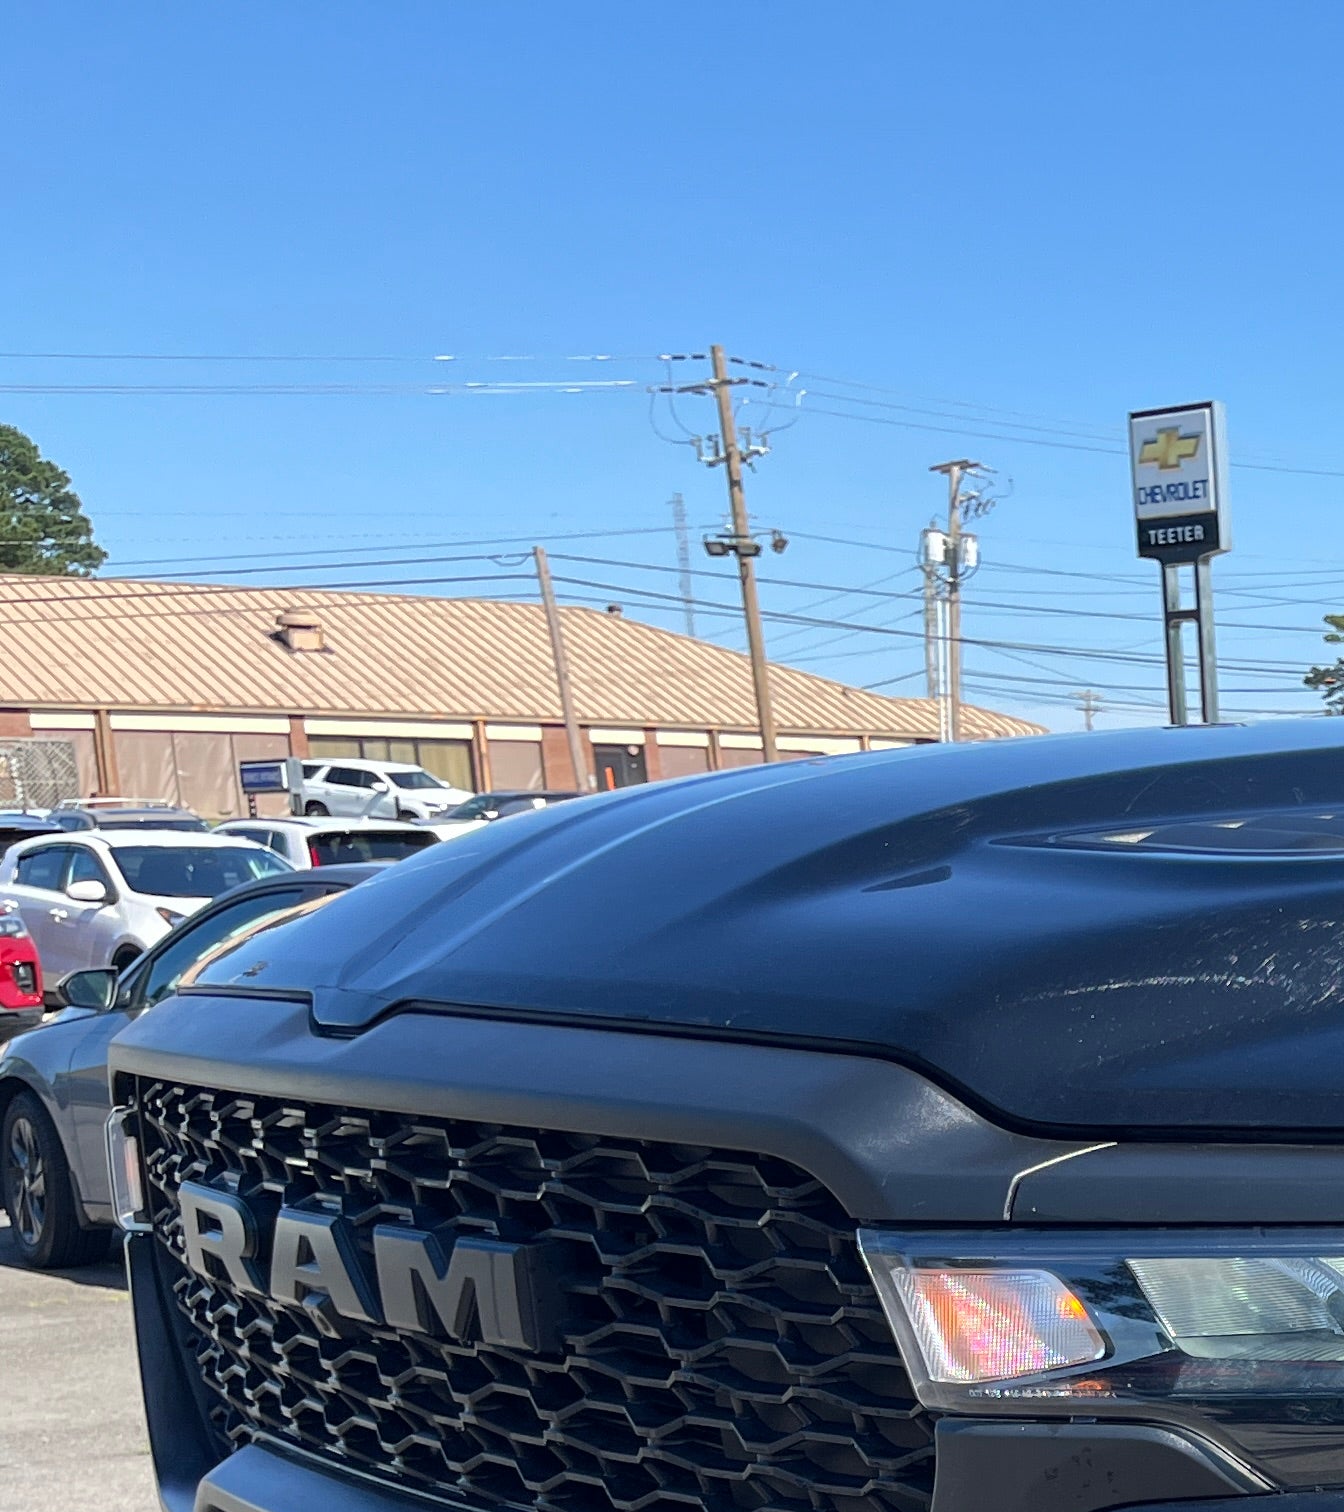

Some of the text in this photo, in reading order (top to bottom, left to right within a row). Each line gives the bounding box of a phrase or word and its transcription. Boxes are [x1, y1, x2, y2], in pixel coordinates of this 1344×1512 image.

[1138, 479, 1208, 505] CHEVROLET
[1148, 525, 1204, 545] TEETER
[178, 1180, 541, 1353] RAM
